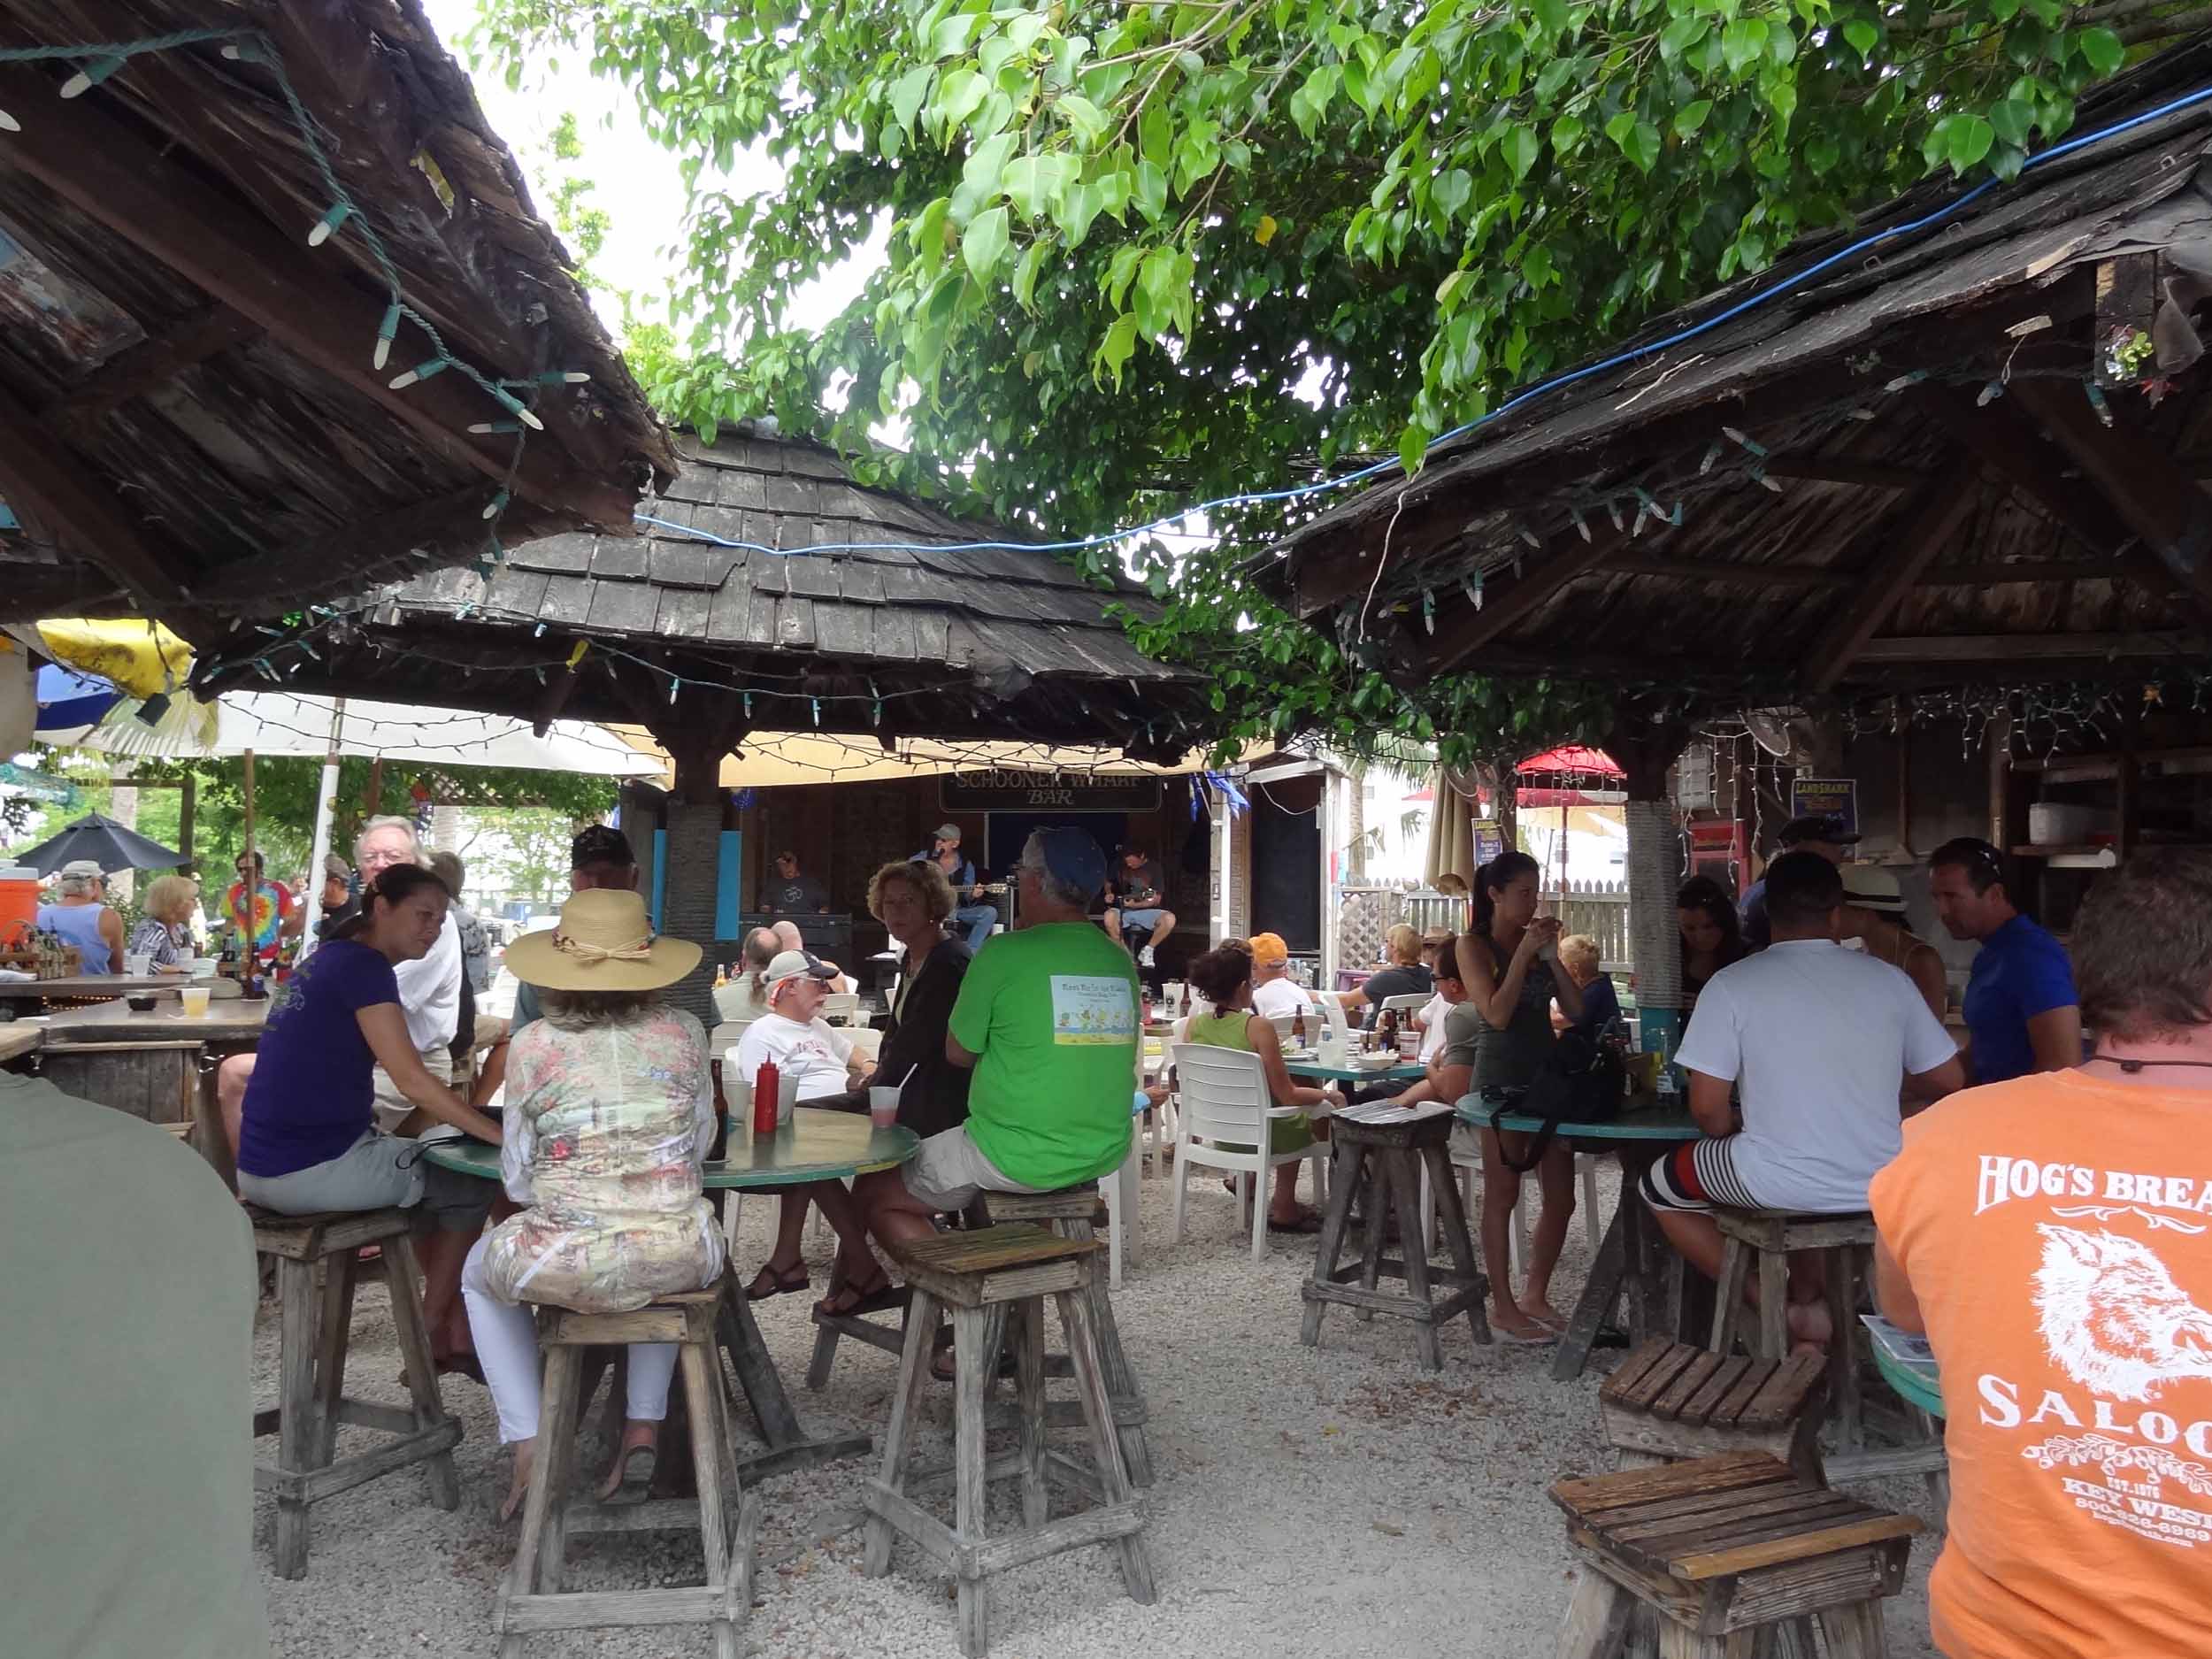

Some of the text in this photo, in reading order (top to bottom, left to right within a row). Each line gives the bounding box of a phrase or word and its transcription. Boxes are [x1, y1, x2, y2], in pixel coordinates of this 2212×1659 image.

[956, 772, 1062, 788] SCHOONER
[1796, 782, 1850, 794] LANDSHARK
[1027, 789, 1075, 805] BAR
[1973, 1154, 2094, 1217] HOG'S
[2061, 1477, 2124, 1507] KEY
